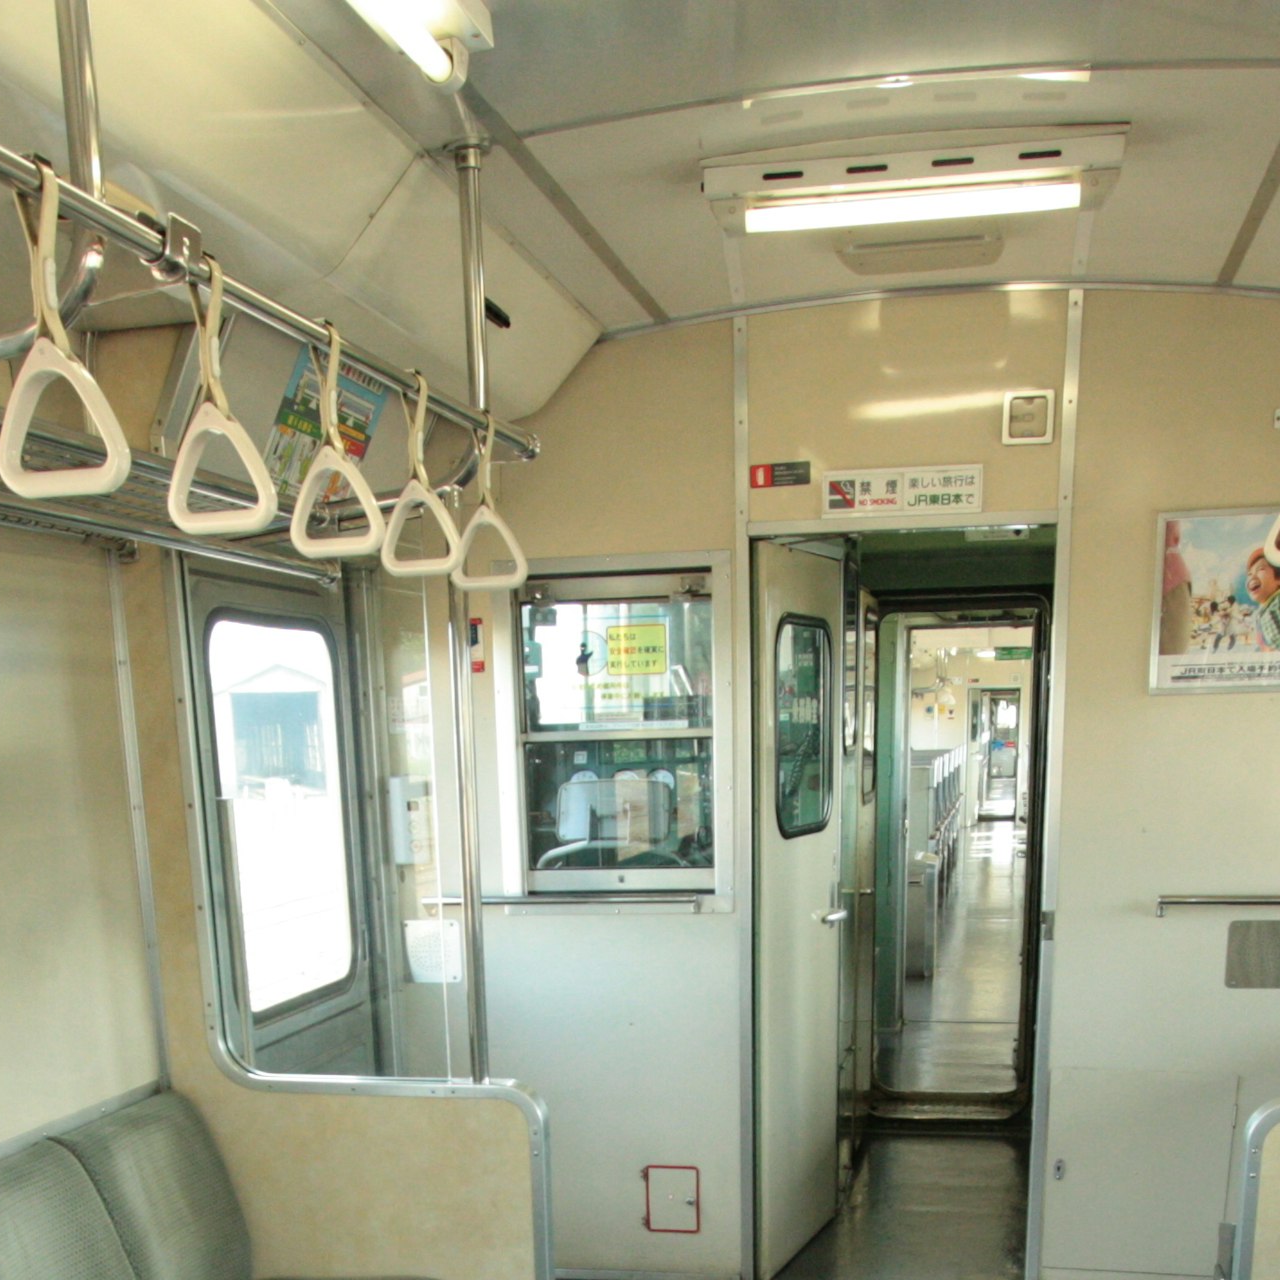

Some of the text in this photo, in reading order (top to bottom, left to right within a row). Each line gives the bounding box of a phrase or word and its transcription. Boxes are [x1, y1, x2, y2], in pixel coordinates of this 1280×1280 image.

[908, 474, 976, 490] 楽しい旅行は
[869, 498, 897, 506] SMOKING
[907, 493, 976, 507] JR東日本で
[608, 633, 637, 641] 私たちは
